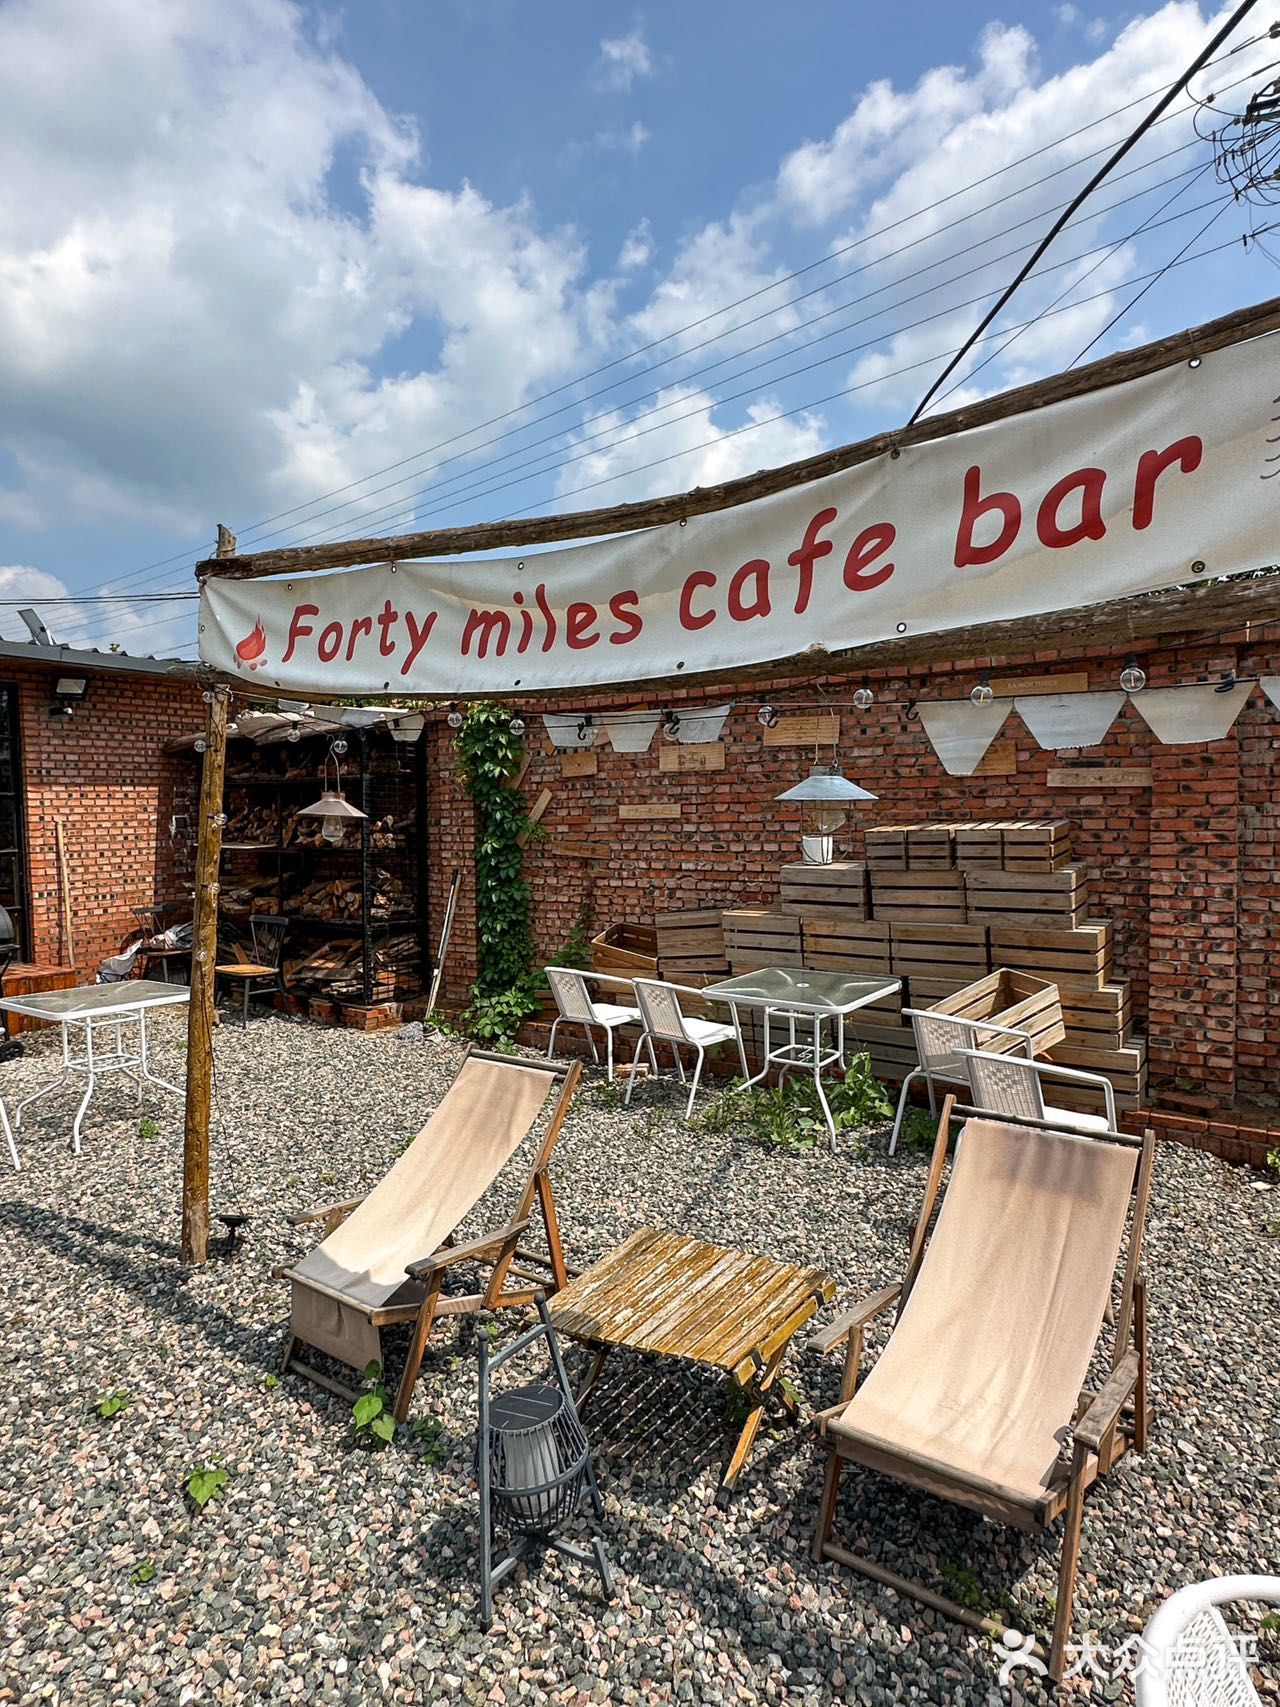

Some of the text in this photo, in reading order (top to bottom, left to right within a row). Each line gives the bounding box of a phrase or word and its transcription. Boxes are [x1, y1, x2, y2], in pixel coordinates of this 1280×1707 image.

[282, 435, 1203, 675] Forty miles cafe bar
